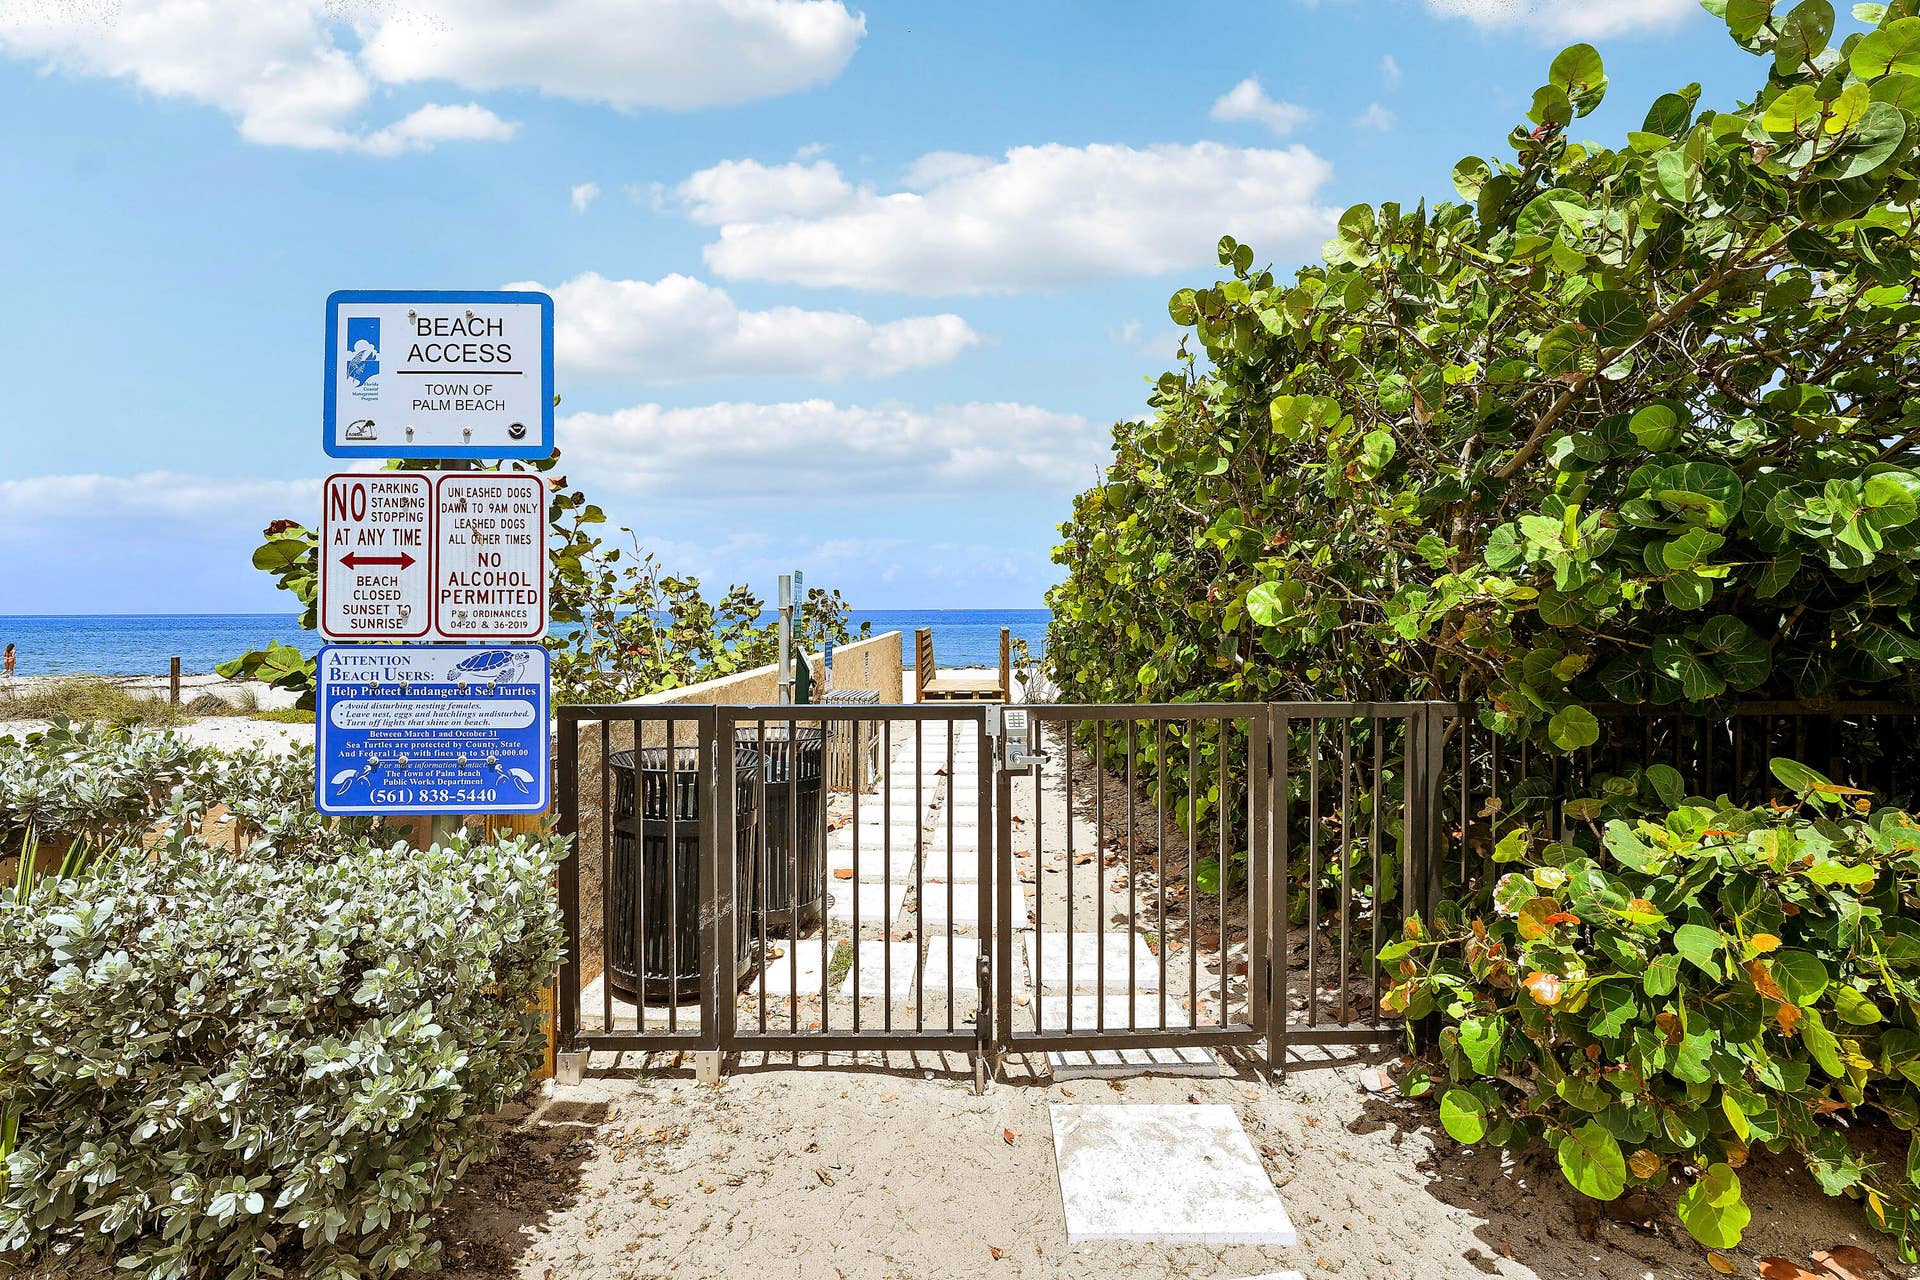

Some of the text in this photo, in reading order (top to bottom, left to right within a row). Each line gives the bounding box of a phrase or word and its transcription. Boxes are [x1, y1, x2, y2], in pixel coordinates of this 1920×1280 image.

[417, 318, 503, 337] BEACH
[407, 343, 512, 363] ACCESS
[425, 384, 493, 395] TOWN OF
[412, 400, 505, 411] PALM BEACH
[371, 483, 419, 494] PARKING
[448, 488, 532, 498] UNLEASHED DOGS
[331, 483, 366, 522] NO
[442, 503, 538, 513] DAWN TO 9AM ONLY
[371, 512, 424, 523] STOPPING
[454, 519, 526, 529] LEASHED DOGS
[334, 528, 422, 546] AT ANY TIME
[448, 534, 532, 545] ALL OHER TIMES
[478, 552, 502, 567] NO
[356, 576, 398, 587] BEACH
[448, 572, 531, 587] ALCOHOL
[353, 590, 401, 601] CLOSED
[441, 590, 538, 604] PERMITTED
[342, 605, 412, 615] SUNSET TO
[472, 610, 528, 618] ORDINANCES
[350, 618, 403, 629] SUNRISE
[450, 621, 528, 629] 04-20 & 36-2019
[329, 652, 411, 666] ATTENTION
[329, 668, 435, 681] BEACH USERS:
[331, 686, 536, 698] Help Protect Endangered Sea Turtles
[371, 703, 414, 711] disturbing
[416, 703, 446, 711] nesting
[447, 703, 482, 711] females.
[372, 711, 392, 719] nest,
[394, 712, 413, 720] eggs
[432, 711, 476, 720] hatchlings
[370, 719, 382, 728] off
[382, 719, 406, 728] lights
[411, 741, 451, 750] protected
[453, 741, 463, 750] by
[466, 741, 498, 750] County,
[437, 778, 483, 787] Department
[369, 788, 497, 804] (561) 838-5440
